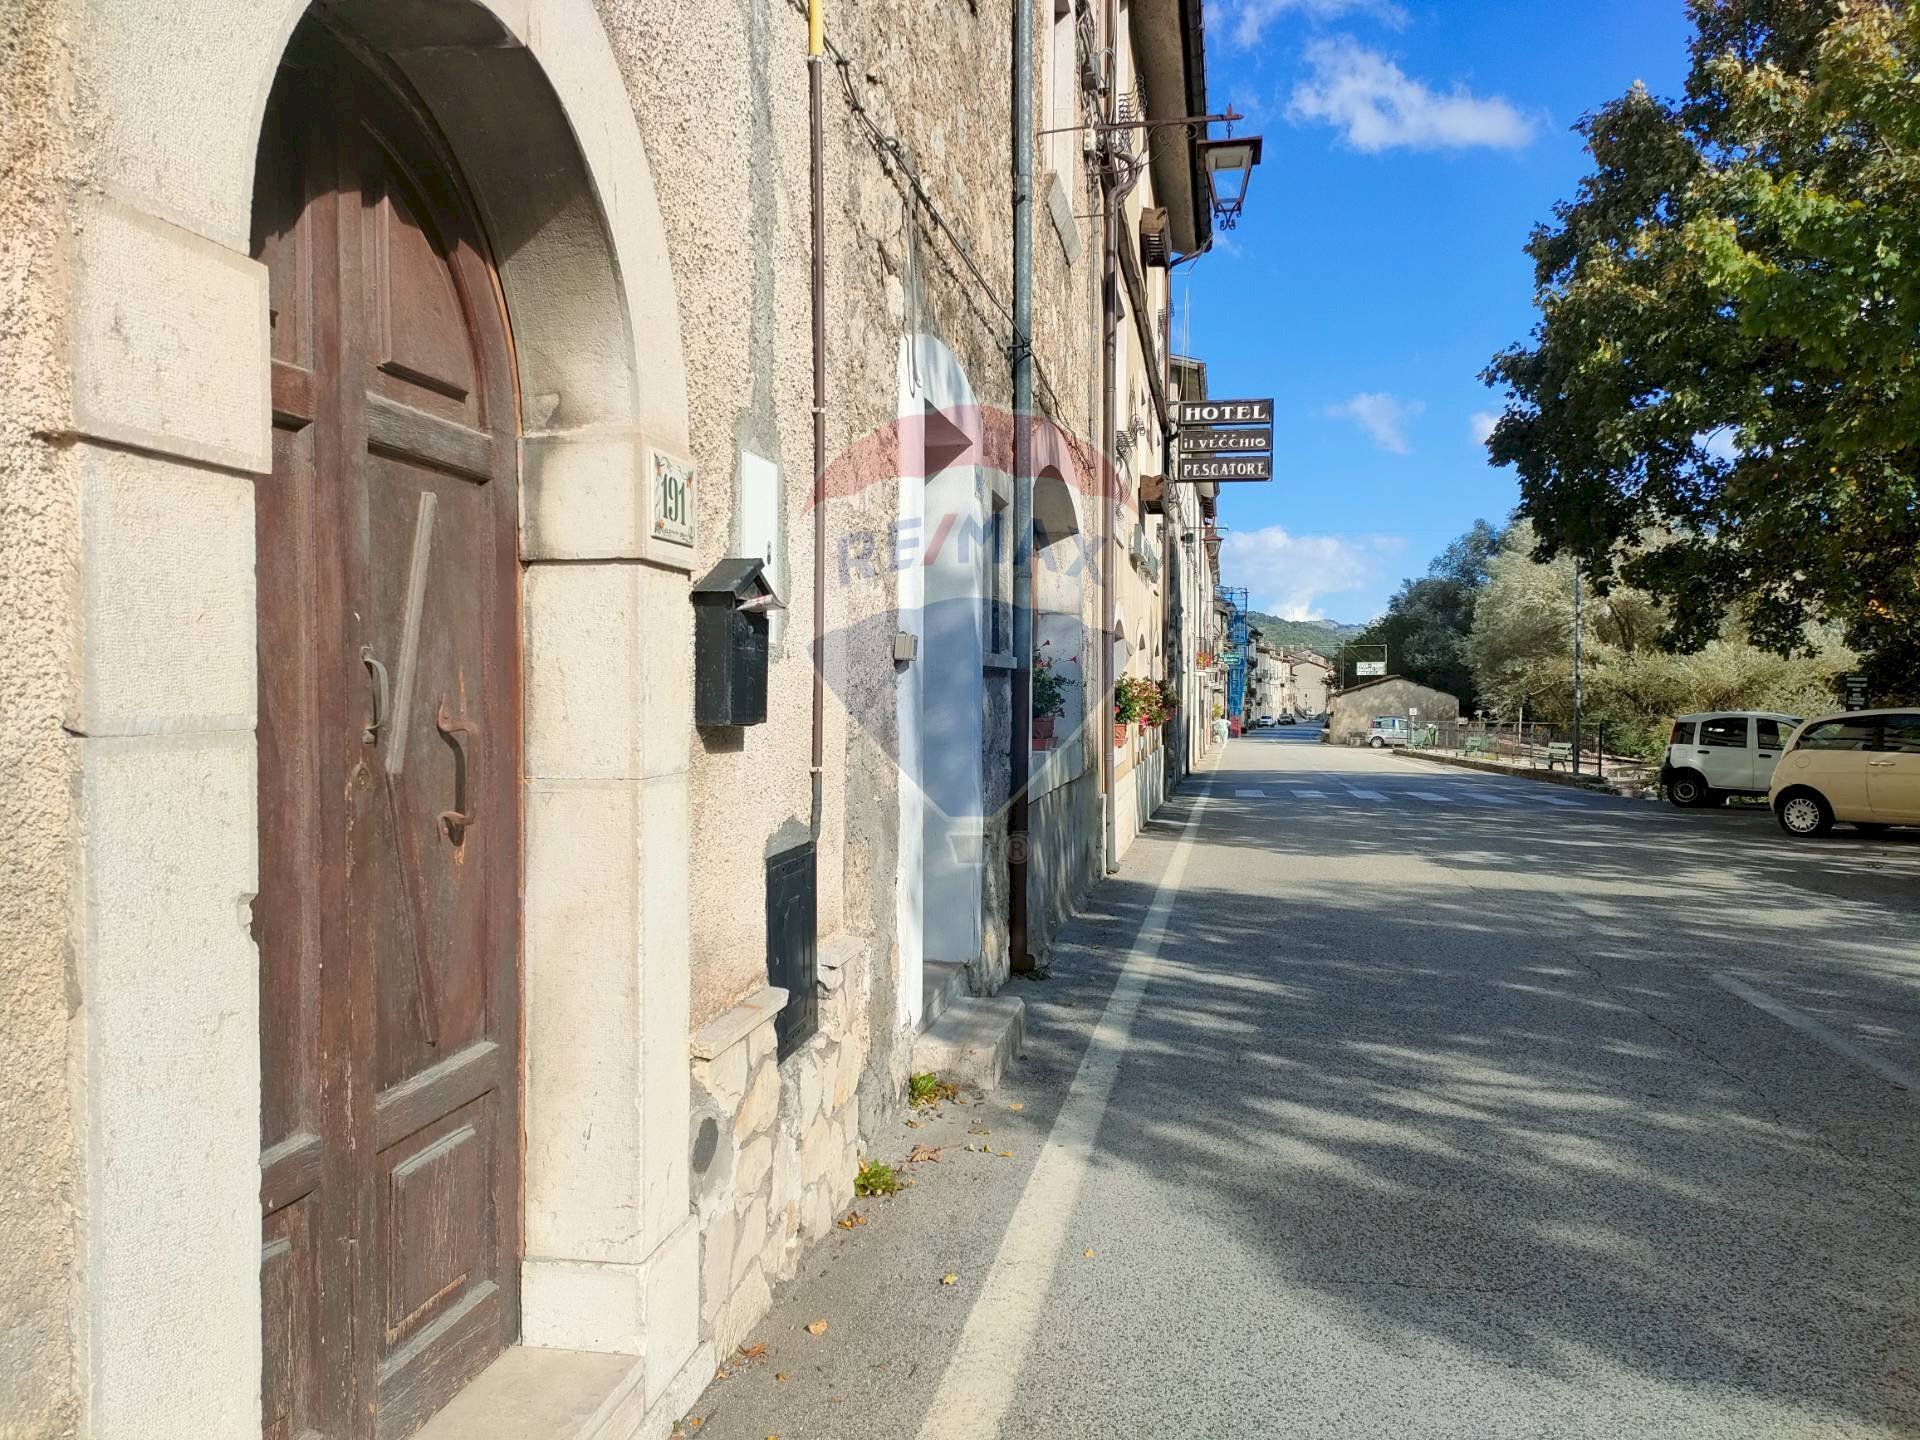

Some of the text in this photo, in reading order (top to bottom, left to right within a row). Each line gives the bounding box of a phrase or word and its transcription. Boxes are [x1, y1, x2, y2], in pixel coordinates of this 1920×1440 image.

[1185, 405, 1266, 420] HOTEL
[1199, 438, 1266, 448] VECCHIO
[1183, 461, 1265, 476] PESCATORE
[661, 473, 686, 526] 191
